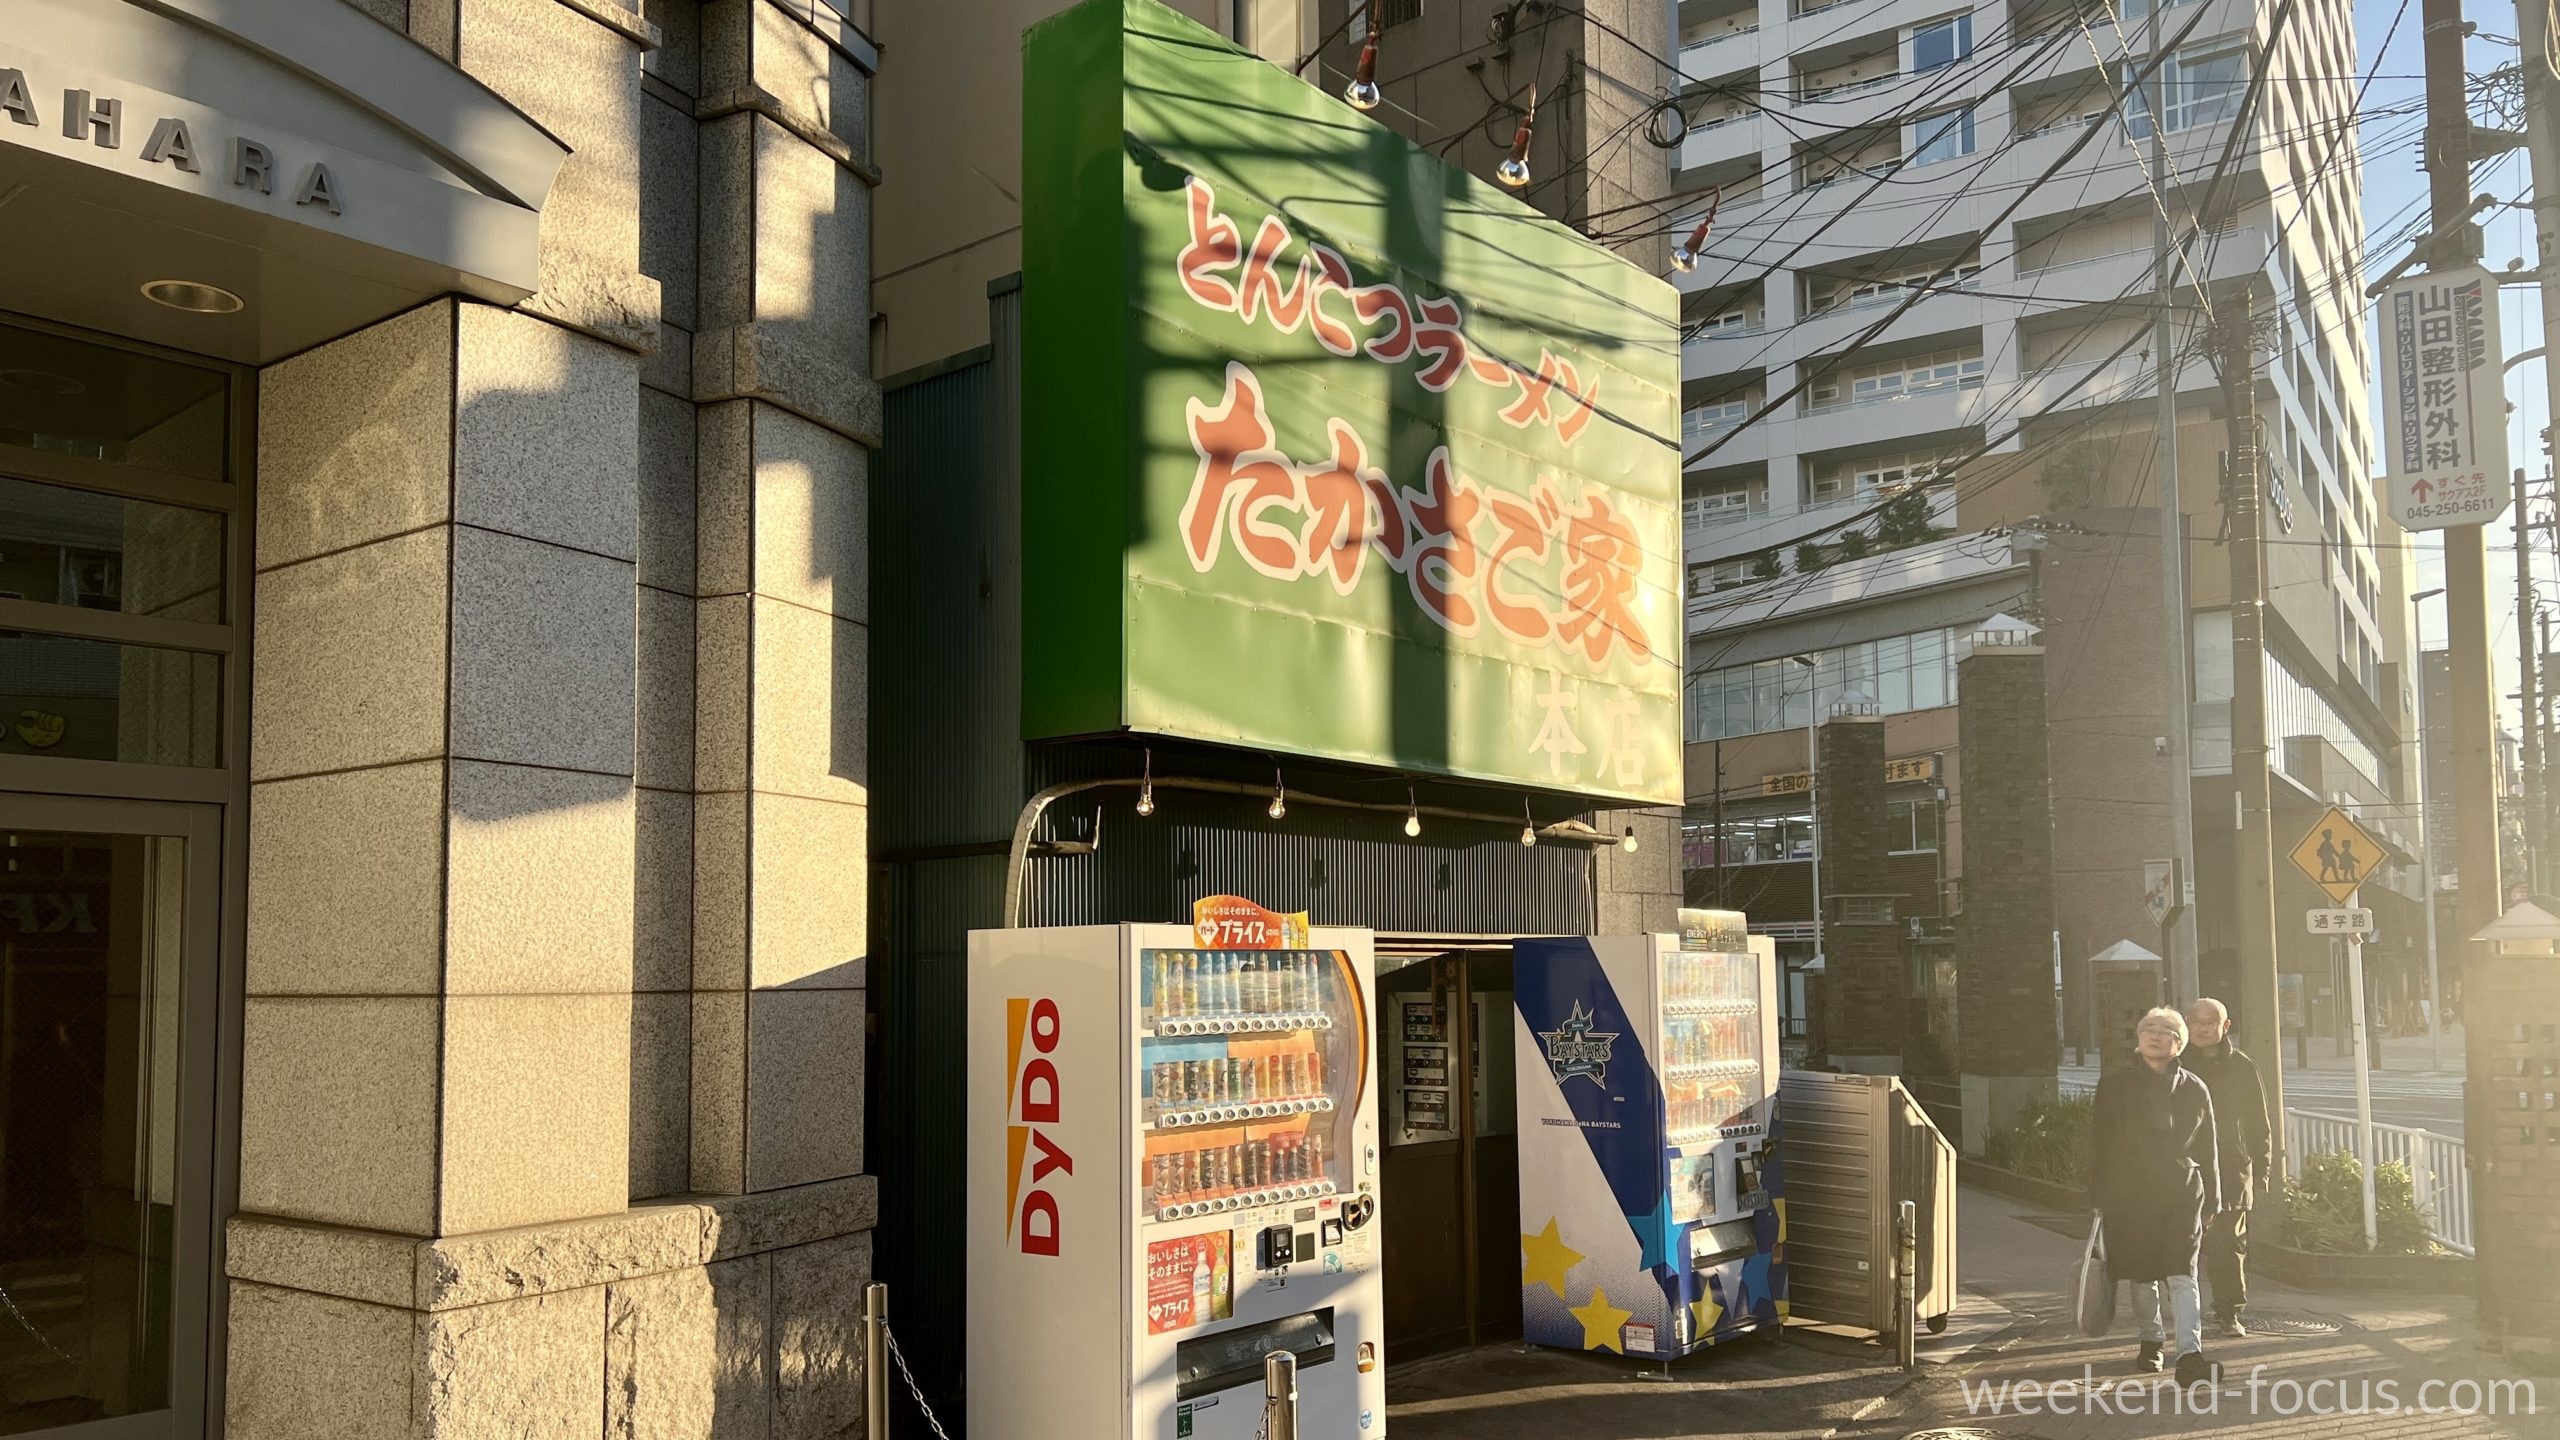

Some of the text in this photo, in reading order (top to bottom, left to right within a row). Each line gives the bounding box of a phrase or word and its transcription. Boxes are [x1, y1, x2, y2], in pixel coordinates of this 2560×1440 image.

[1178, 176, 1600, 449] とんこつラーメン
[2418, 285, 2461, 470] 山田整形外科
[2436, 472, 2486, 488] すぐ先
[2438, 485, 2486, 502] サクアス2F
[1179, 360, 1652, 674] たかさご家
[2407, 498, 2496, 520] 045-250-6611
[1529, 677, 1647, 788] 本店
[1220, 919, 1266, 944] プライス
[2314, 913, 2366, 930] 通学路
[1550, 1034, 1611, 1060] BAYSTARS
[1021, 998, 1073, 1257] DyDo
[1591, 1121, 1622, 1129] BAYSTARS
[1148, 1245, 1190, 1265] おいしさは
[1149, 1261, 1193, 1280] そのままに。
[1163, 1298, 1190, 1318] プライス
